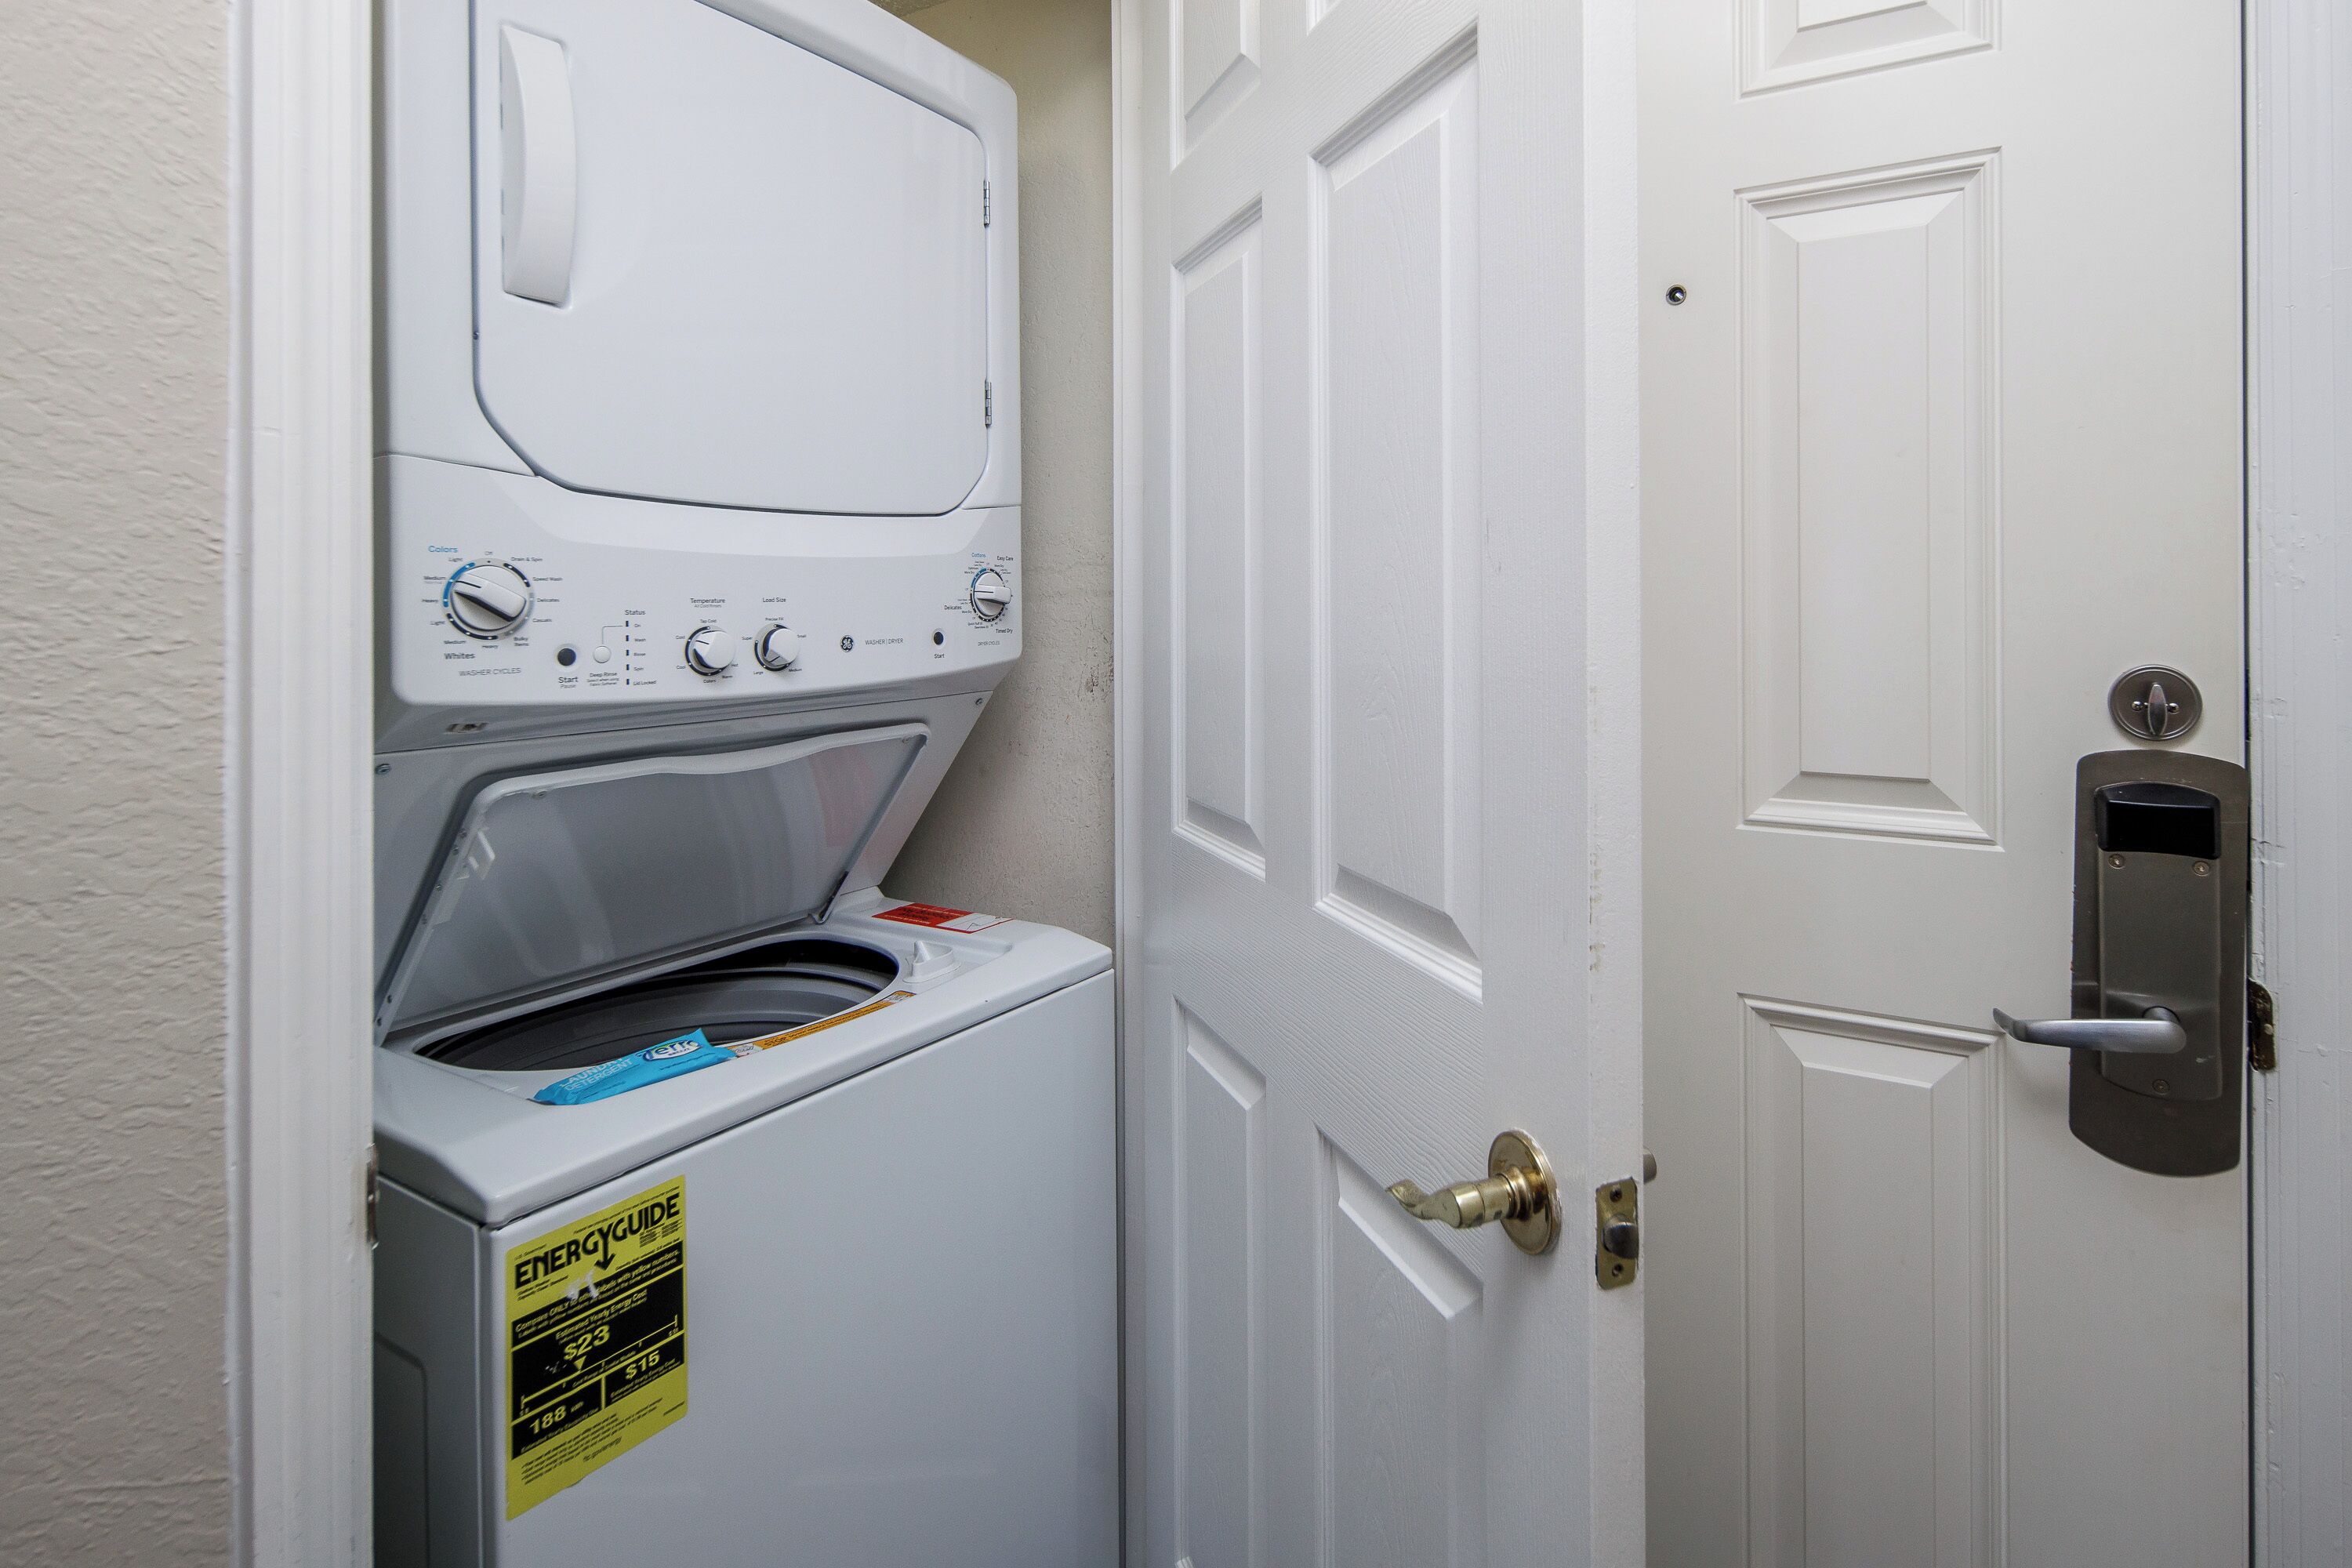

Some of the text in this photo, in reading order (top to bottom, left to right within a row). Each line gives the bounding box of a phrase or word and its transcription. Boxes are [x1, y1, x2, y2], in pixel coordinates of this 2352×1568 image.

[564, 1058, 633, 1091] DETERGENT
[514, 1192, 681, 1290] ENERGYGUIDE
[549, 1301, 569, 1315] ONLY
[631, 1262, 651, 1276] yellow
[610, 1298, 631, 1312] Energy
[632, 1289, 647, 1301] Cost
[564, 1324, 610, 1361] $23
[626, 1350, 660, 1380] $15
[529, 1405, 567, 1434] 188
